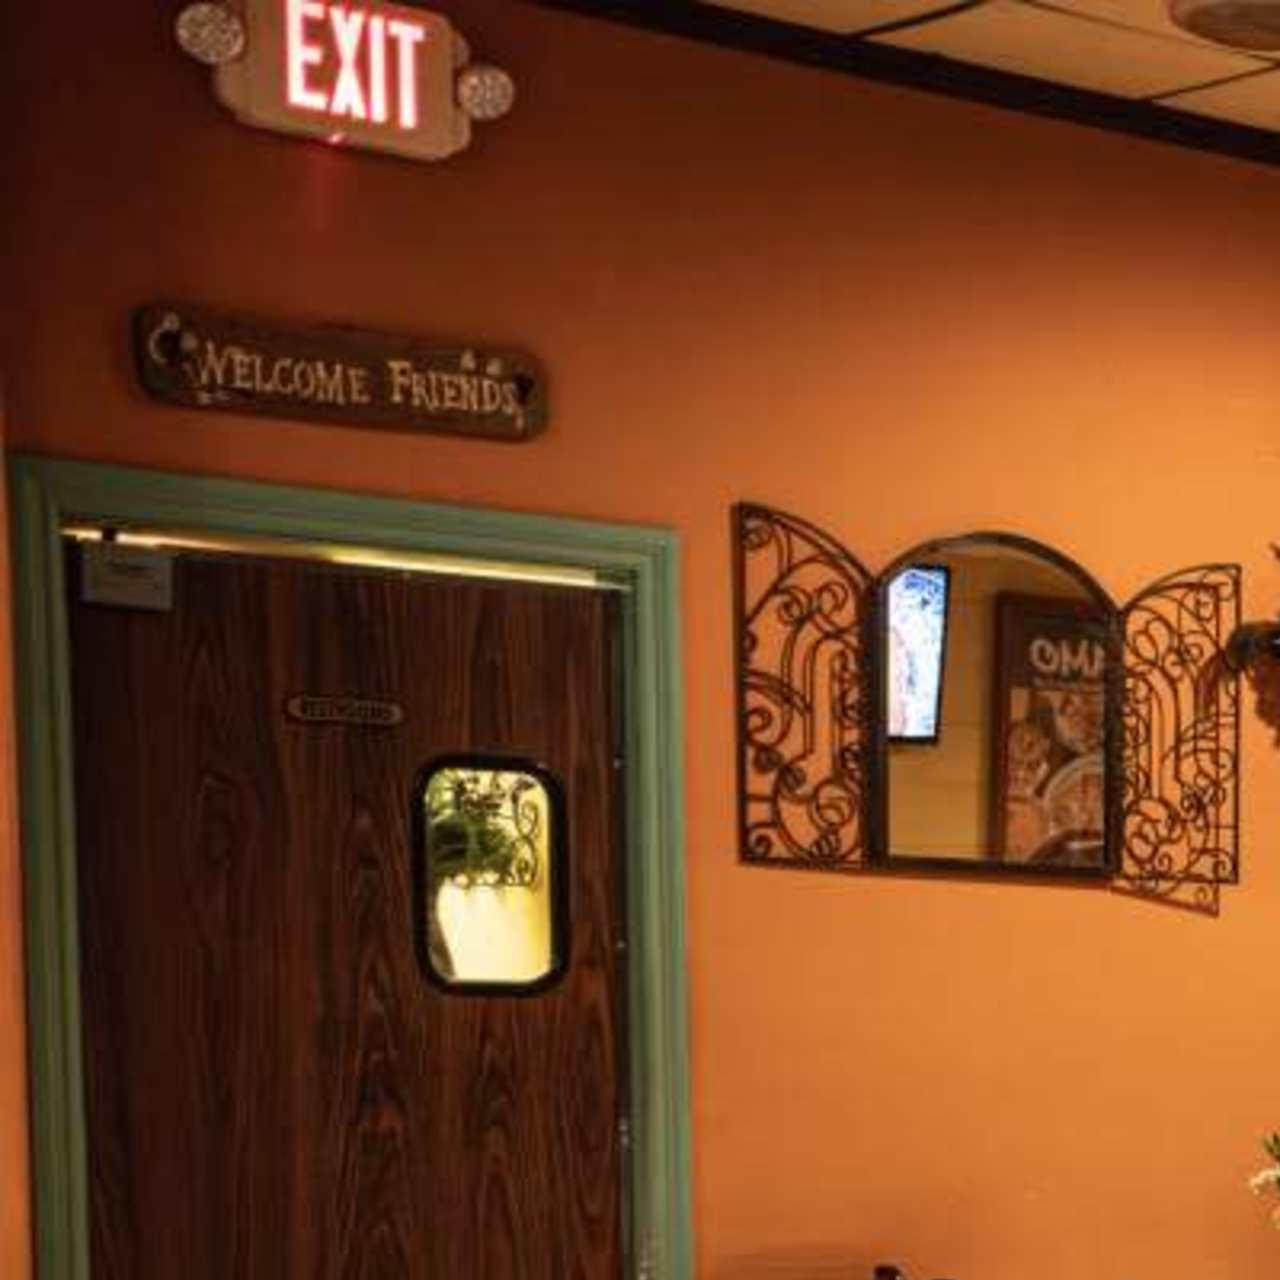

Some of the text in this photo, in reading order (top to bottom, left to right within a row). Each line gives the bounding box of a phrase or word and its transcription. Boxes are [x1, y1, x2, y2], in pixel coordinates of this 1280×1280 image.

[286, 0, 425, 129] EXIT
[188, 341, 522, 415] WELCOME FRIENDS
